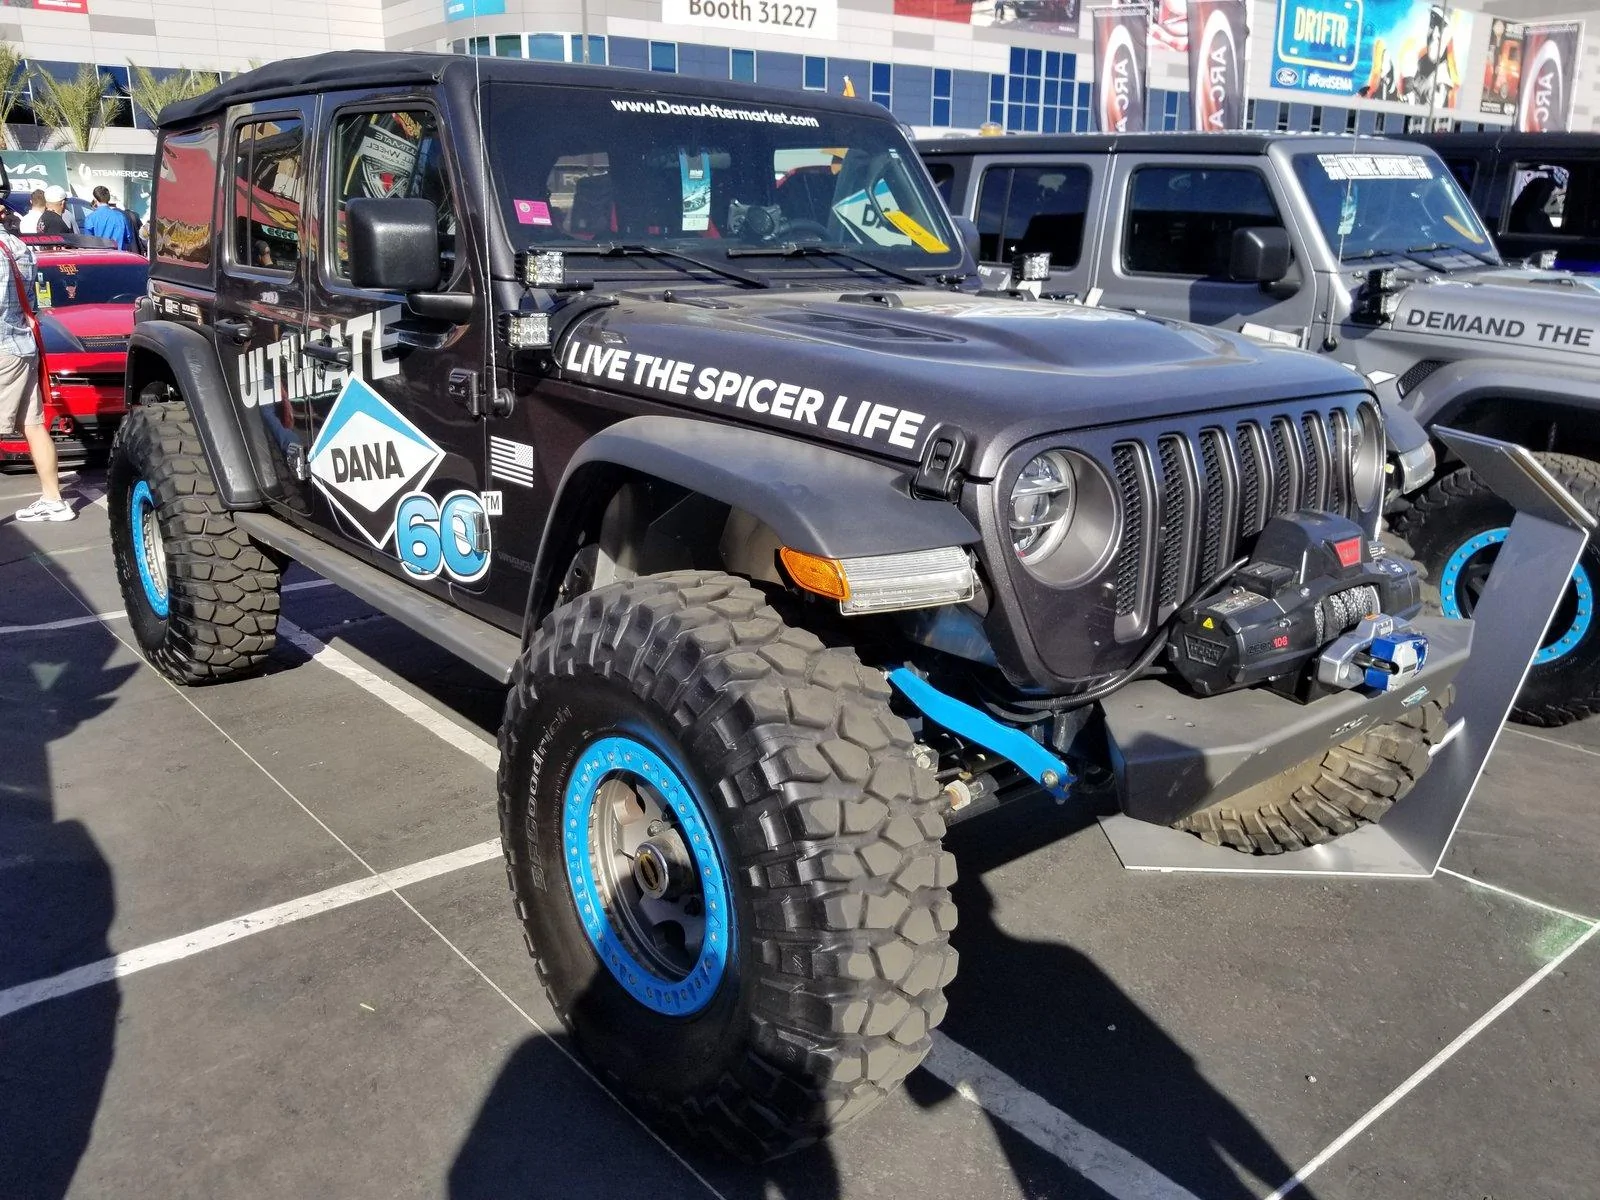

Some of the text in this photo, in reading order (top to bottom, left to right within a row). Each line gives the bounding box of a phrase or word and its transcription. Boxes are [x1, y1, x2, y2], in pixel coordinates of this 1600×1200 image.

[689, 0, 817, 29] Booth 31227
[611, 99, 820, 127] www.DanaAftermarket.com
[1406, 309, 1594, 347] DEMAND THE
[238, 304, 402, 408] ULTIMATE
[566, 342, 926, 449] LIVE THE SPICER LIFE
[330, 440, 405, 484] DANA
[395, 490, 500, 582] 60 TM
